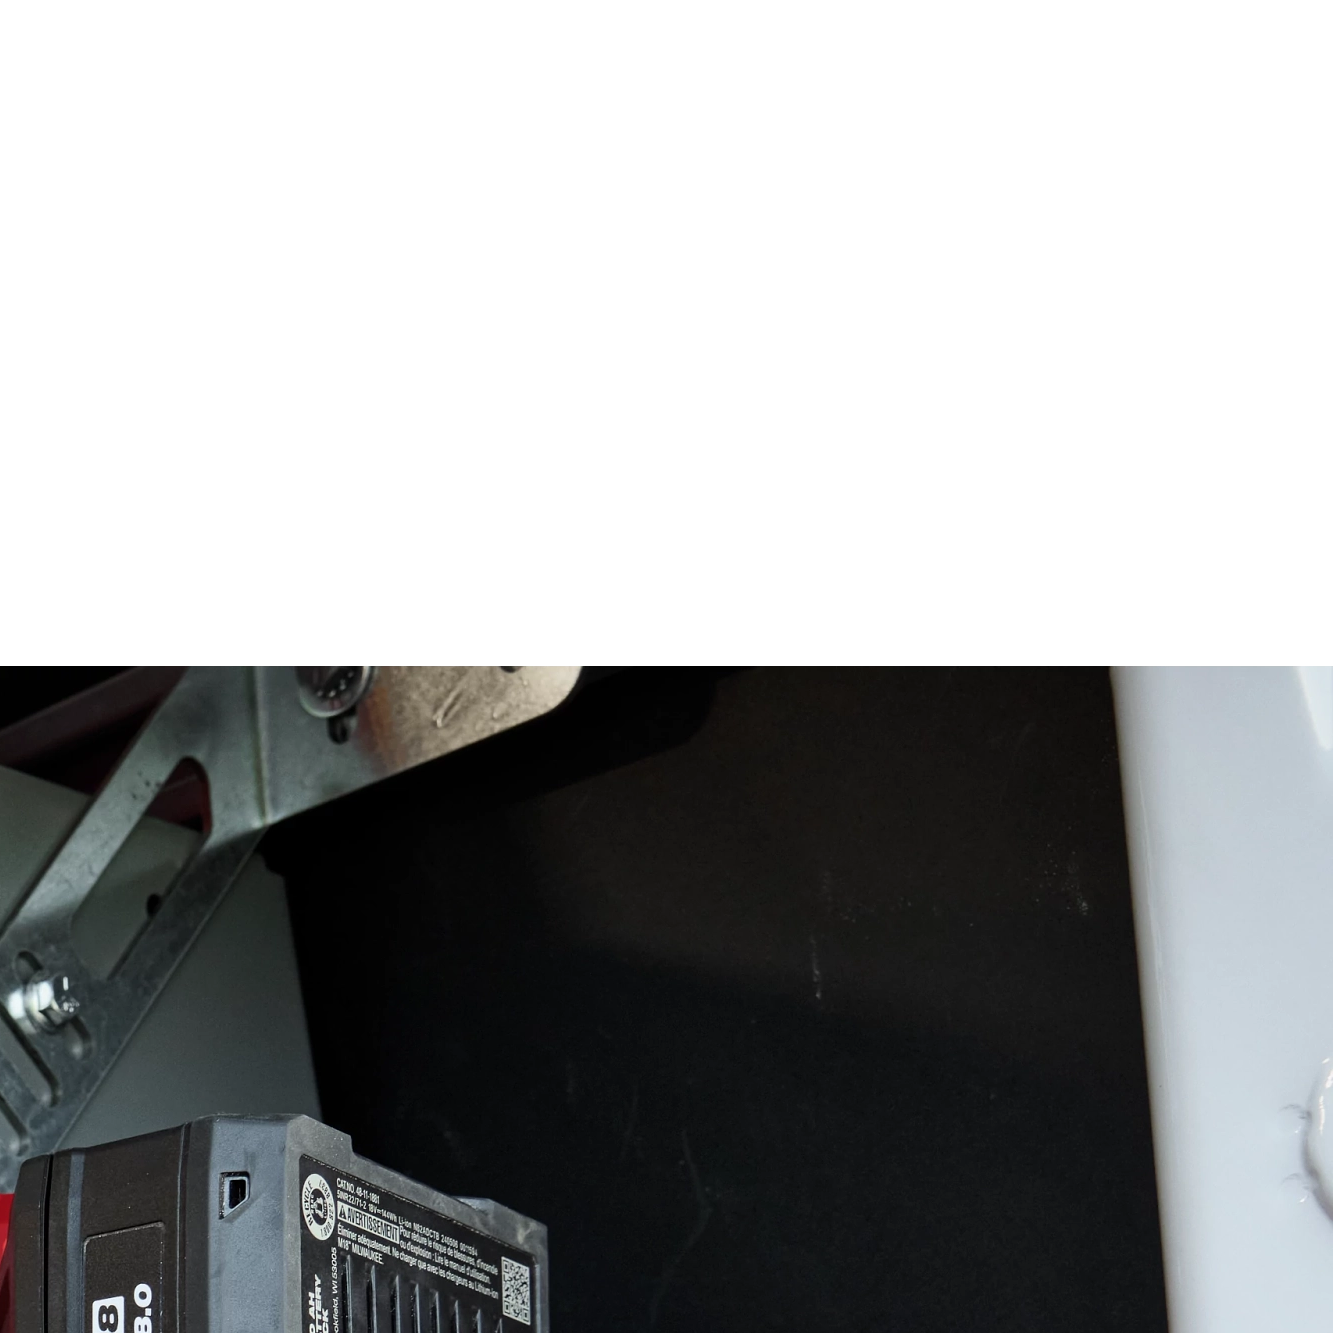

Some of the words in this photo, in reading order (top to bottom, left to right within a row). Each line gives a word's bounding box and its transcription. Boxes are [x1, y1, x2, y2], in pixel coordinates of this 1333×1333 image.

[348, 1208, 397, 1240] AVERTISSEMENT
[332, 1280, 338, 1293] WI
[309, 1292, 314, 1319] AH
